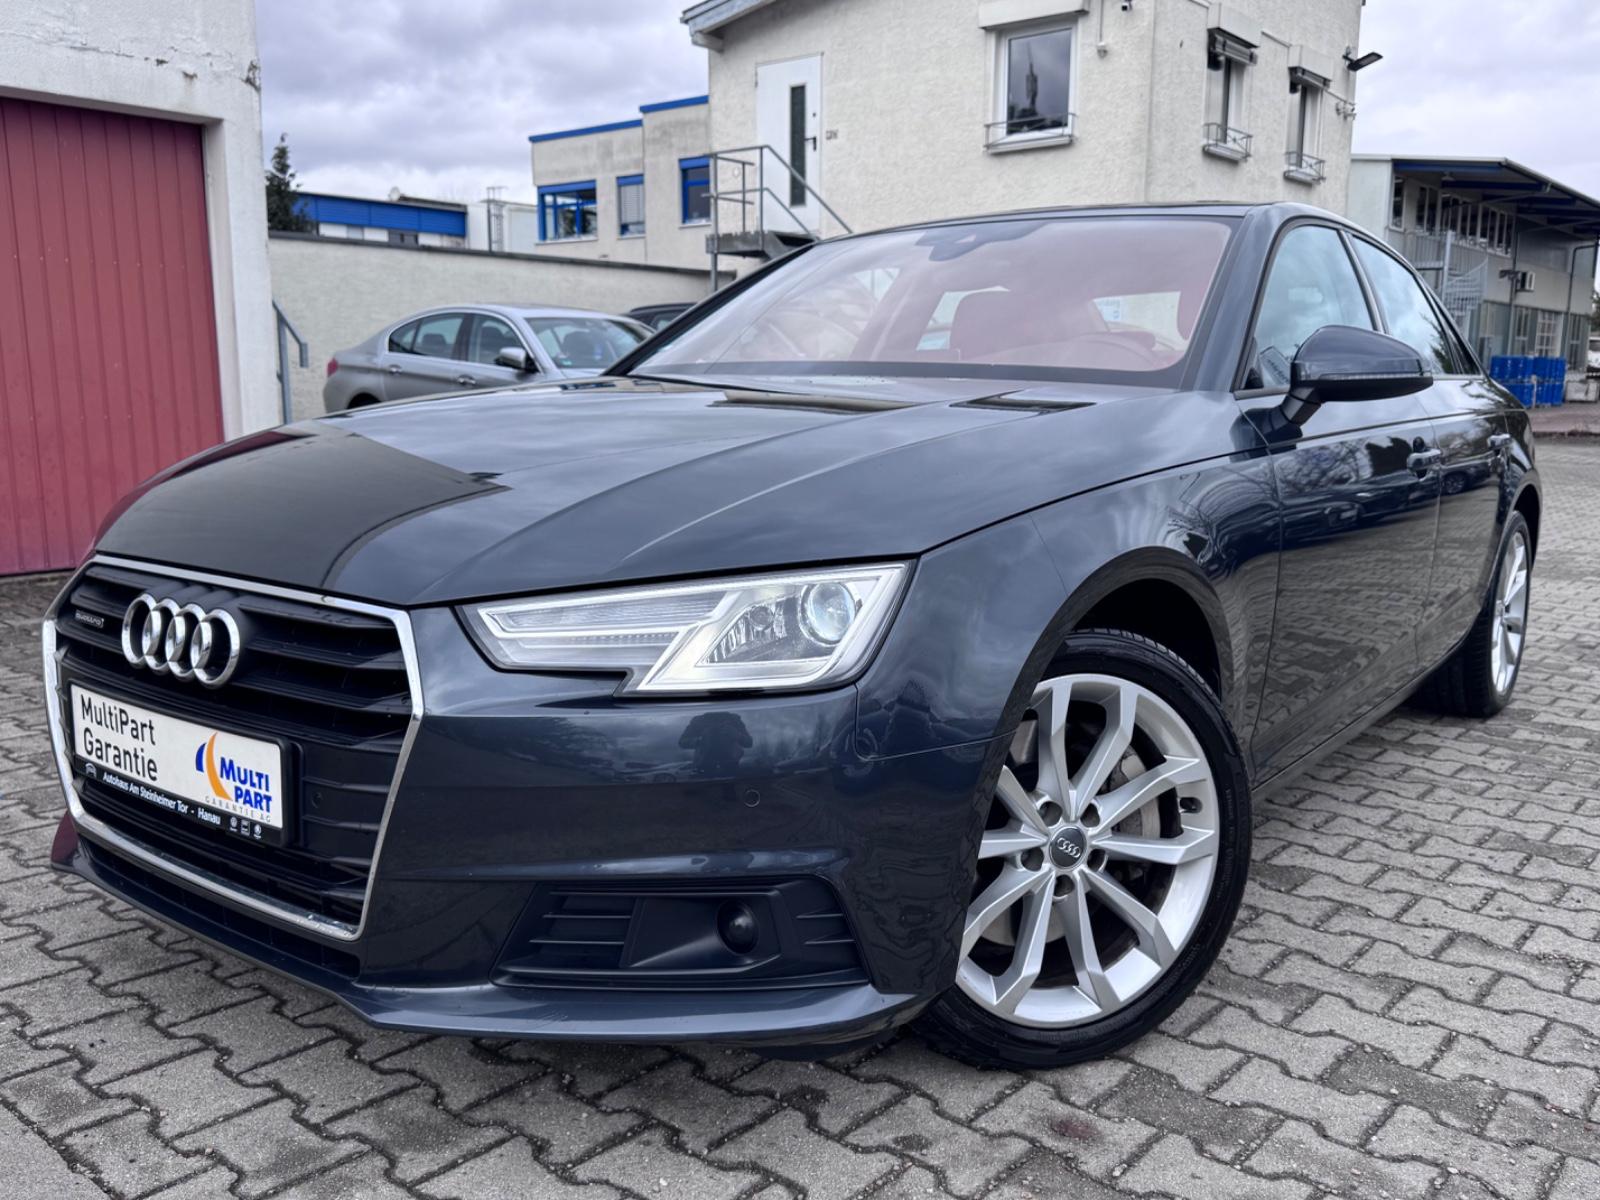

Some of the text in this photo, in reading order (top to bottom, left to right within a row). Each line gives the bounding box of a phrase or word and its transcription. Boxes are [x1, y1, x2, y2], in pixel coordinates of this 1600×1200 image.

[81, 694, 156, 746] MultiPart
[84, 727, 157, 782] Garantie
[220, 756, 270, 793] MULTI
[103, 771, 129, 791] Autohaus
[129, 783, 140, 796] Am
[177, 799, 189, 814] Tor
[197, 807, 221, 825] Hanau
[234, 785, 273, 813] PART
